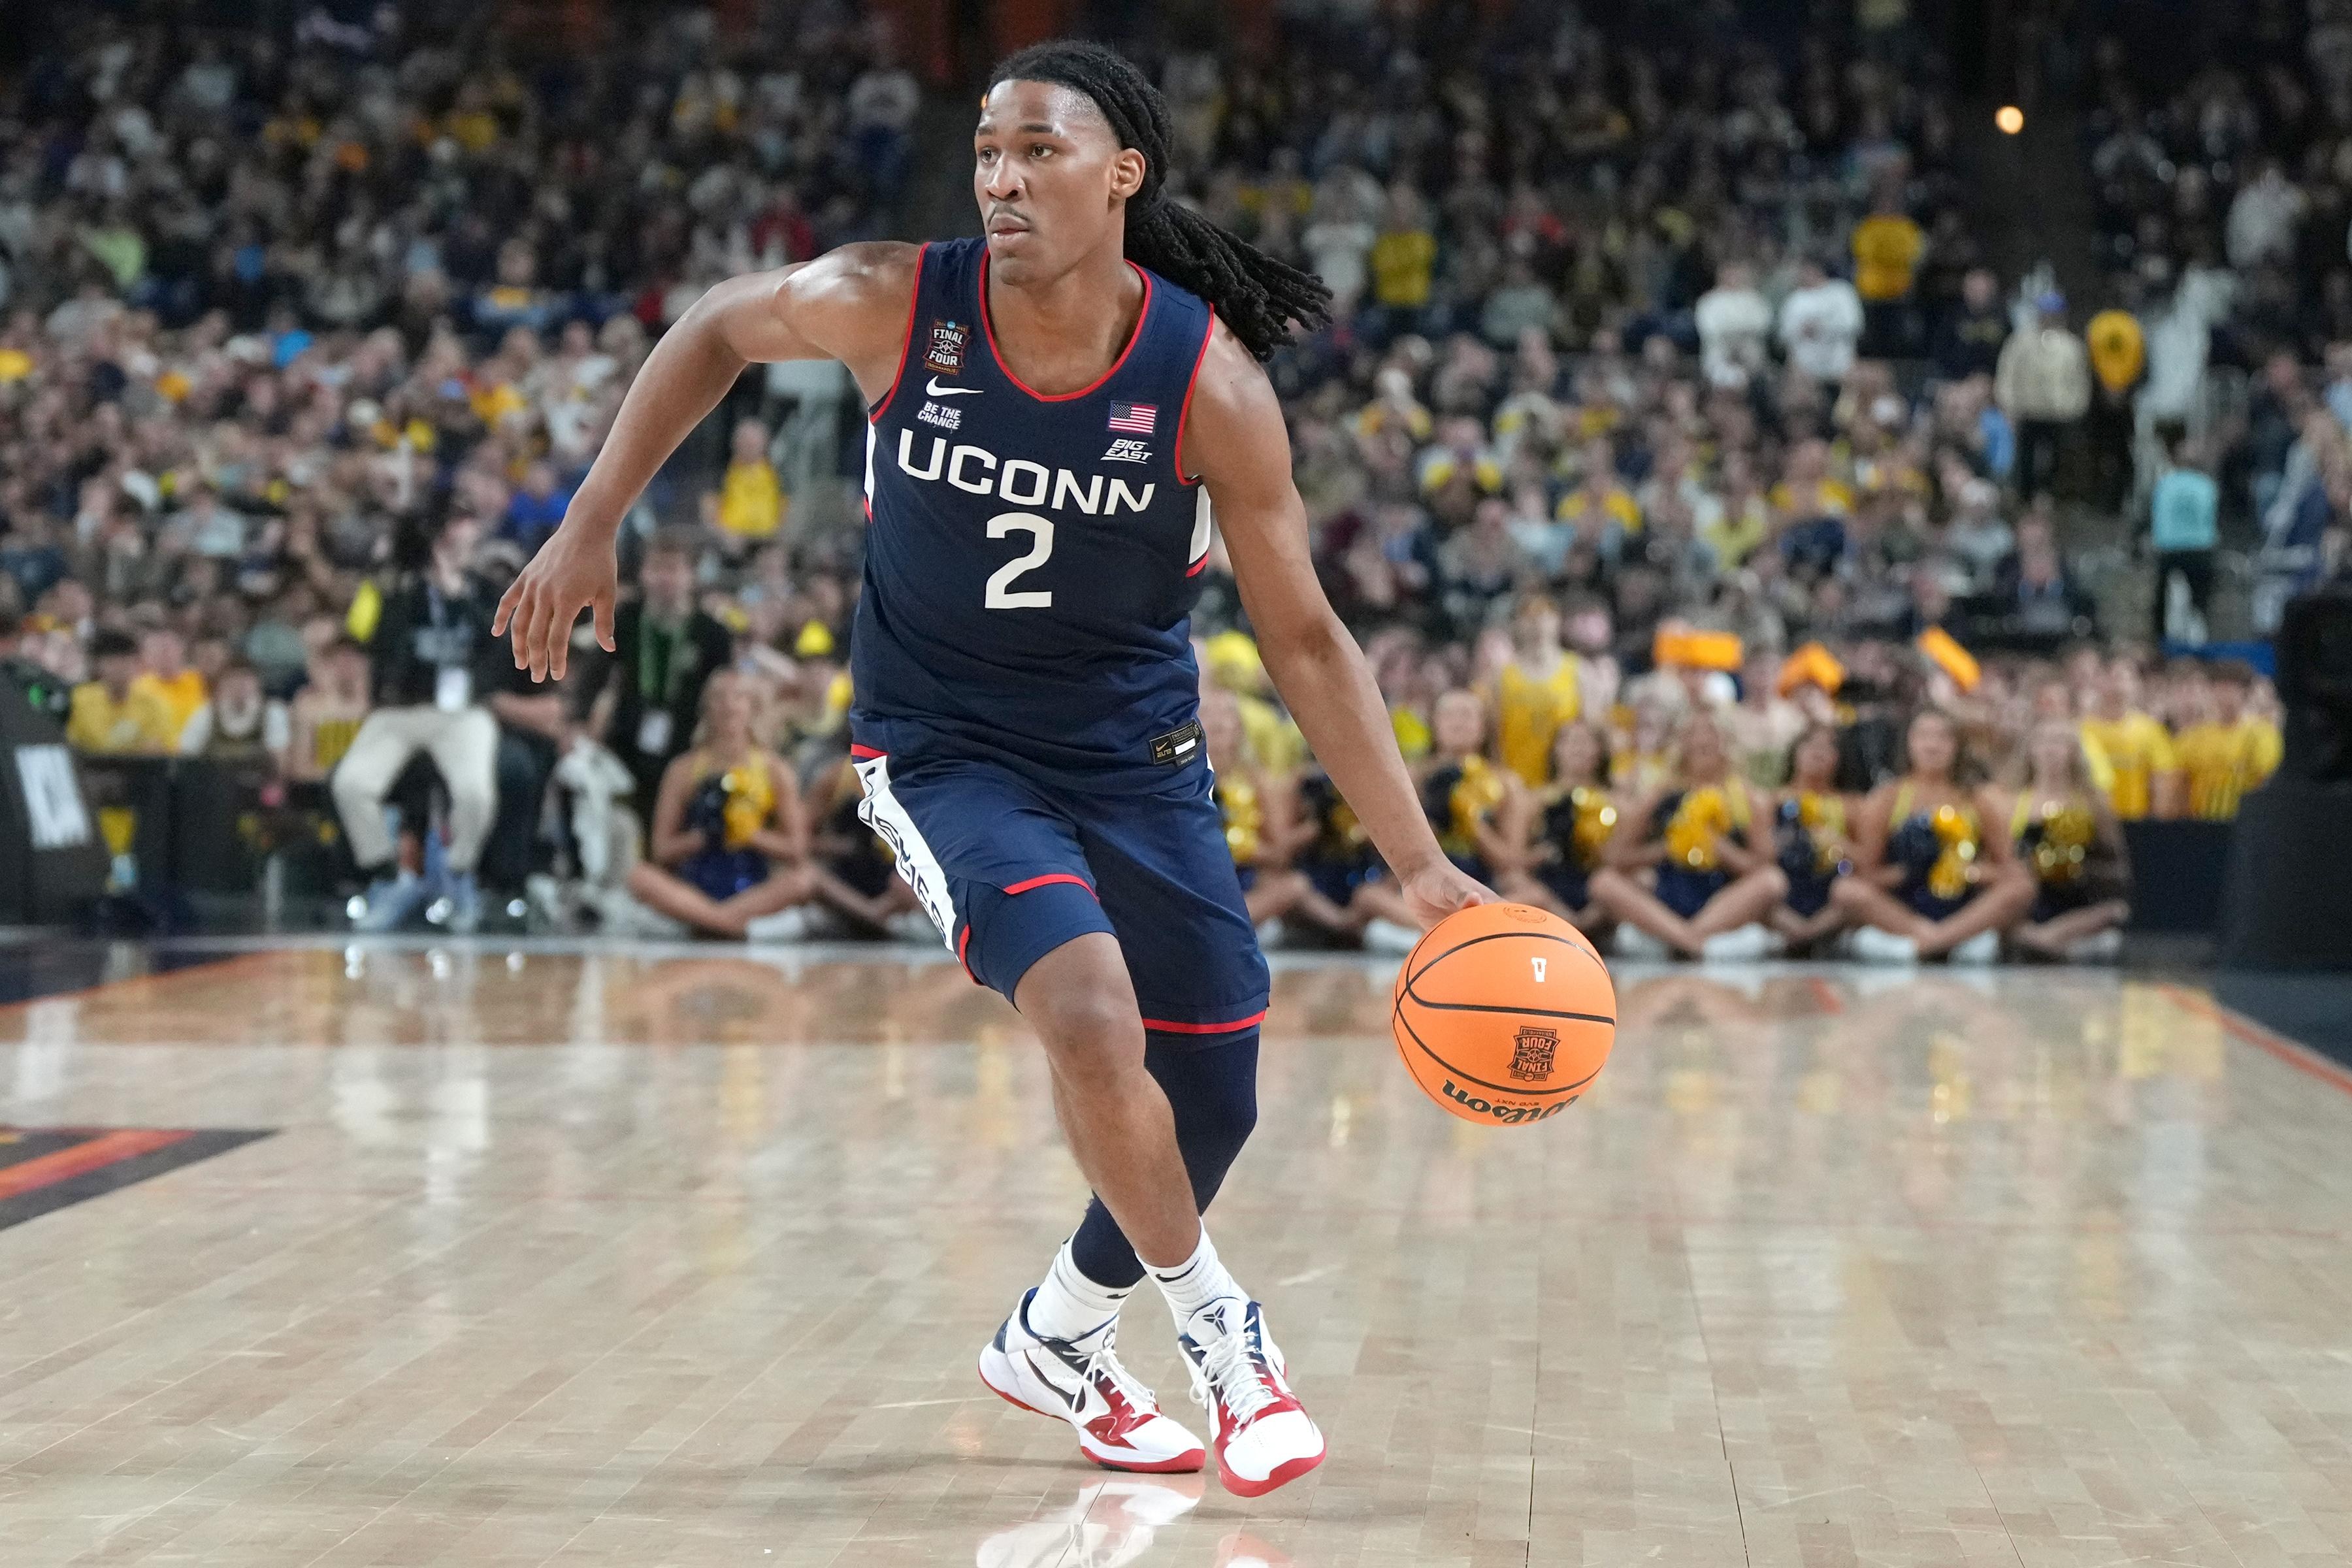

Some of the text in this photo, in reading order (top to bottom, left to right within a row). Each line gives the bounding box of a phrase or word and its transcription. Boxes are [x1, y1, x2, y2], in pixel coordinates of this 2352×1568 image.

[934, 329, 963, 345] FINAL
[928, 350, 958, 366] FOUR
[924, 402, 961, 419] BE THE
[917, 410, 961, 430] CHANGE
[1111, 438, 1146, 451] BIG
[1105, 448, 1152, 460] EAST
[898, 428, 1155, 515] UCONN
[985, 512, 1054, 609] 2
[1522, 1037, 1552, 1051] FOUR
[1517, 1059, 1548, 1073] FINAL
